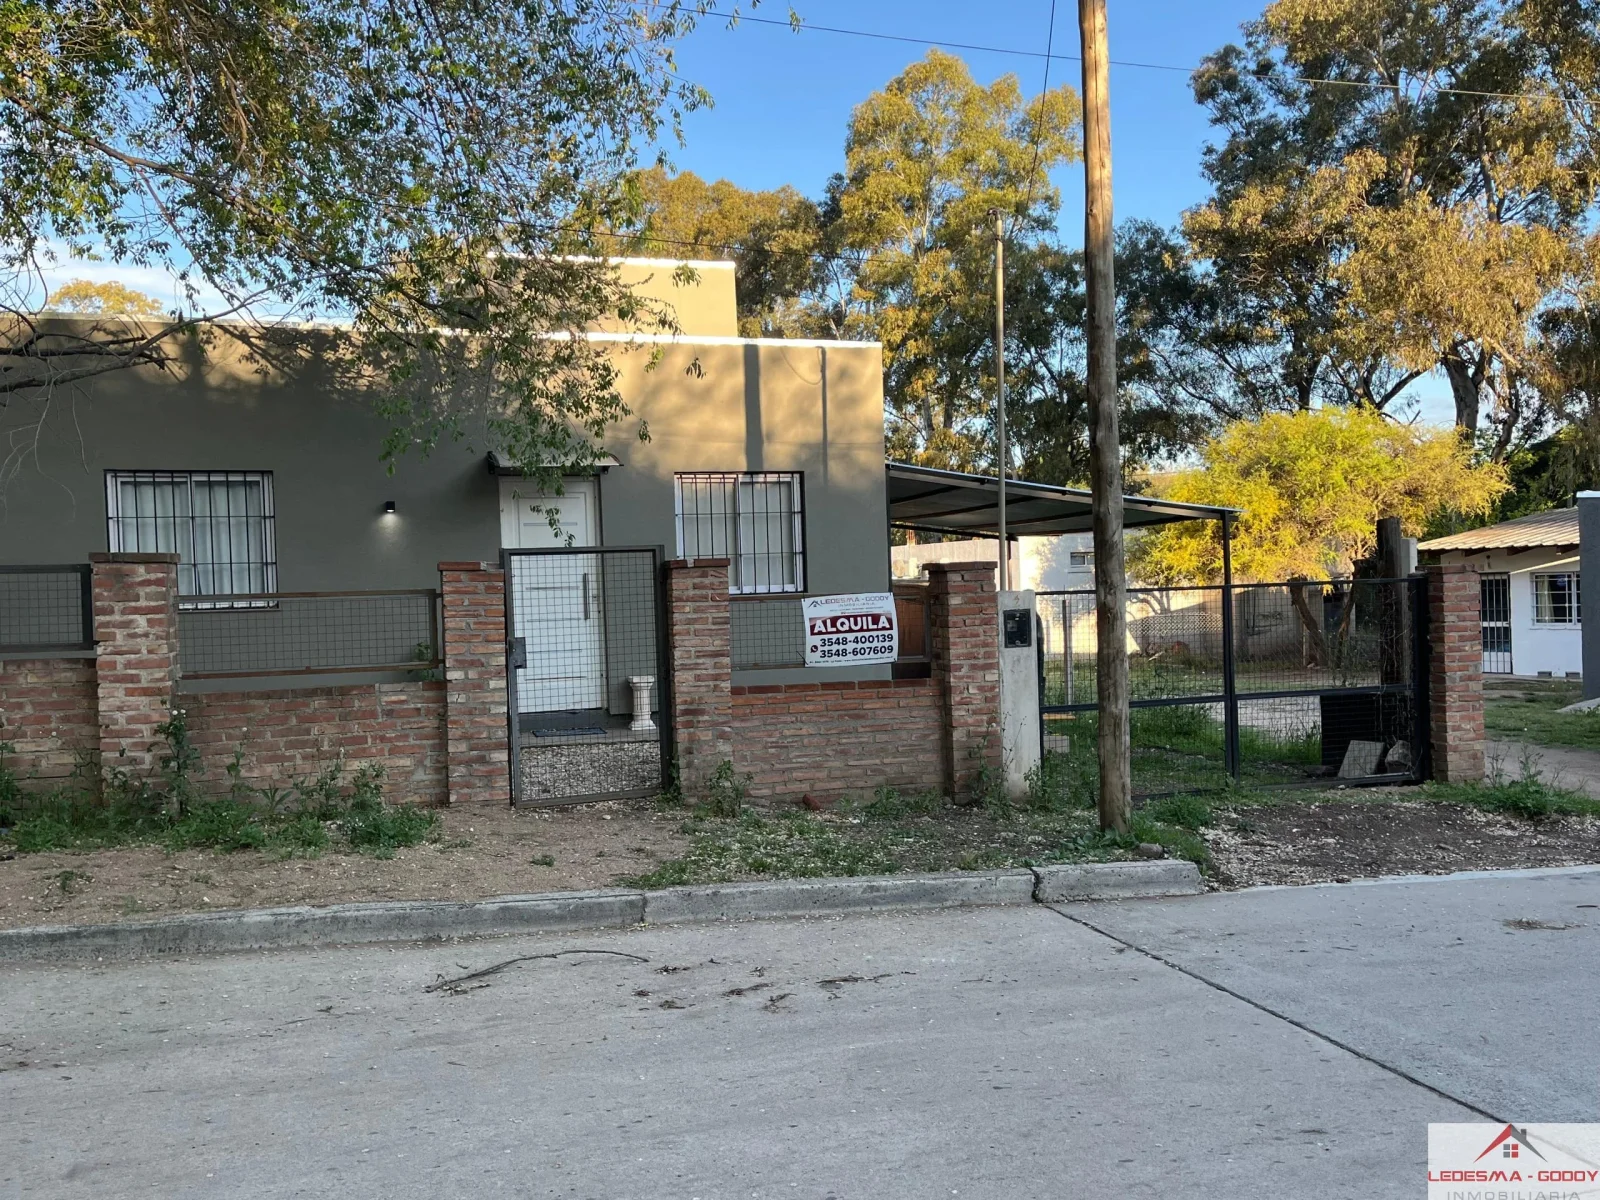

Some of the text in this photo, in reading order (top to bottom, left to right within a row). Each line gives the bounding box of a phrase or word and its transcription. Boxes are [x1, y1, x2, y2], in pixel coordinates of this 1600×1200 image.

[820, 597, 860, 605] LEDESMA
[813, 615, 890, 633] ALQUILA
[820, 633, 894, 647] 3548-400139
[820, 645, 894, 658] 3548-607609
